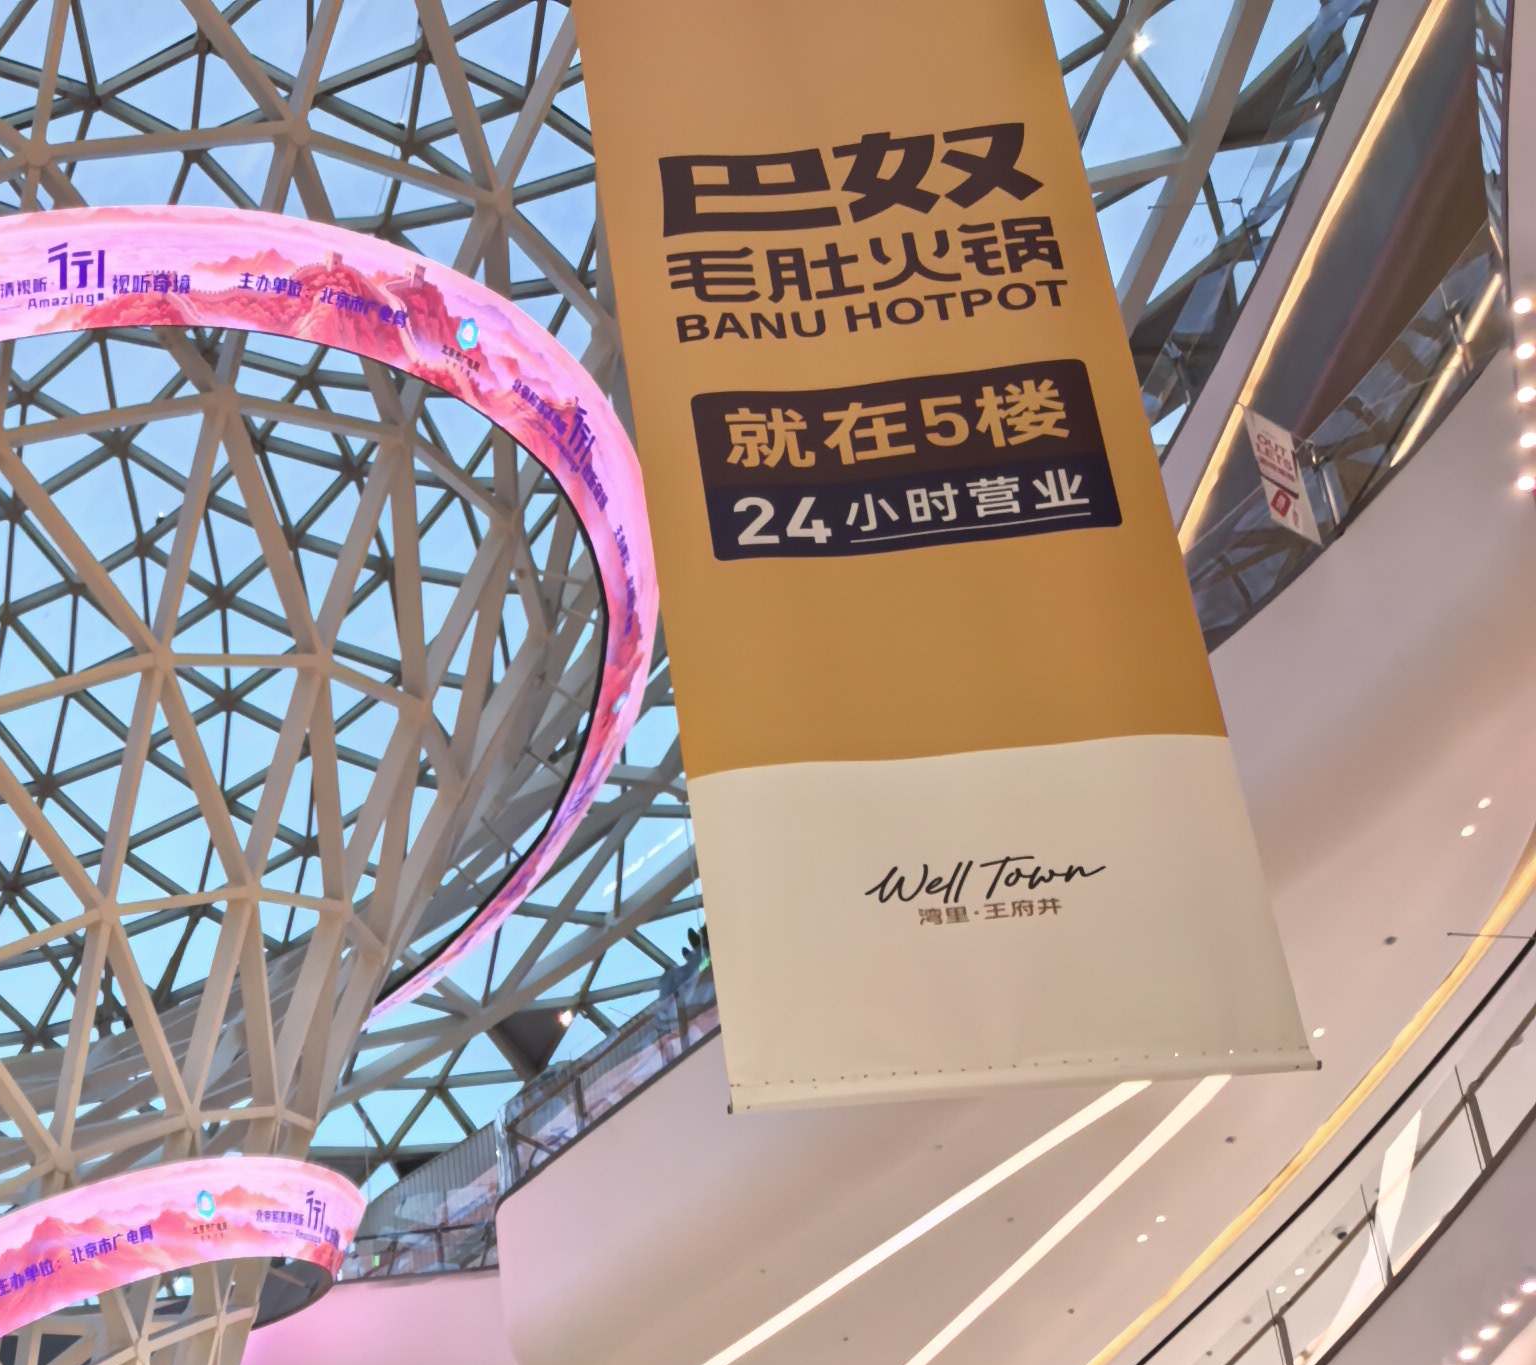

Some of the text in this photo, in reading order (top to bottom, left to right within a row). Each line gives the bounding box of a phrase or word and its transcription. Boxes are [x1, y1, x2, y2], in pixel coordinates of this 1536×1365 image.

[659, 123, 1044, 237] 巴奴
[667, 216, 1064, 303] 毛肚火锅
[27, 291, 95, 311] Amazing
[676, 280, 1067, 343] BANU HOTPOT
[725, 379, 1069, 467] 就在5楼
[734, 469, 1090, 545] 24小时营业
[865, 856, 1107, 905] Well Town
[920, 897, 1061, 925] 湾里·王府井
